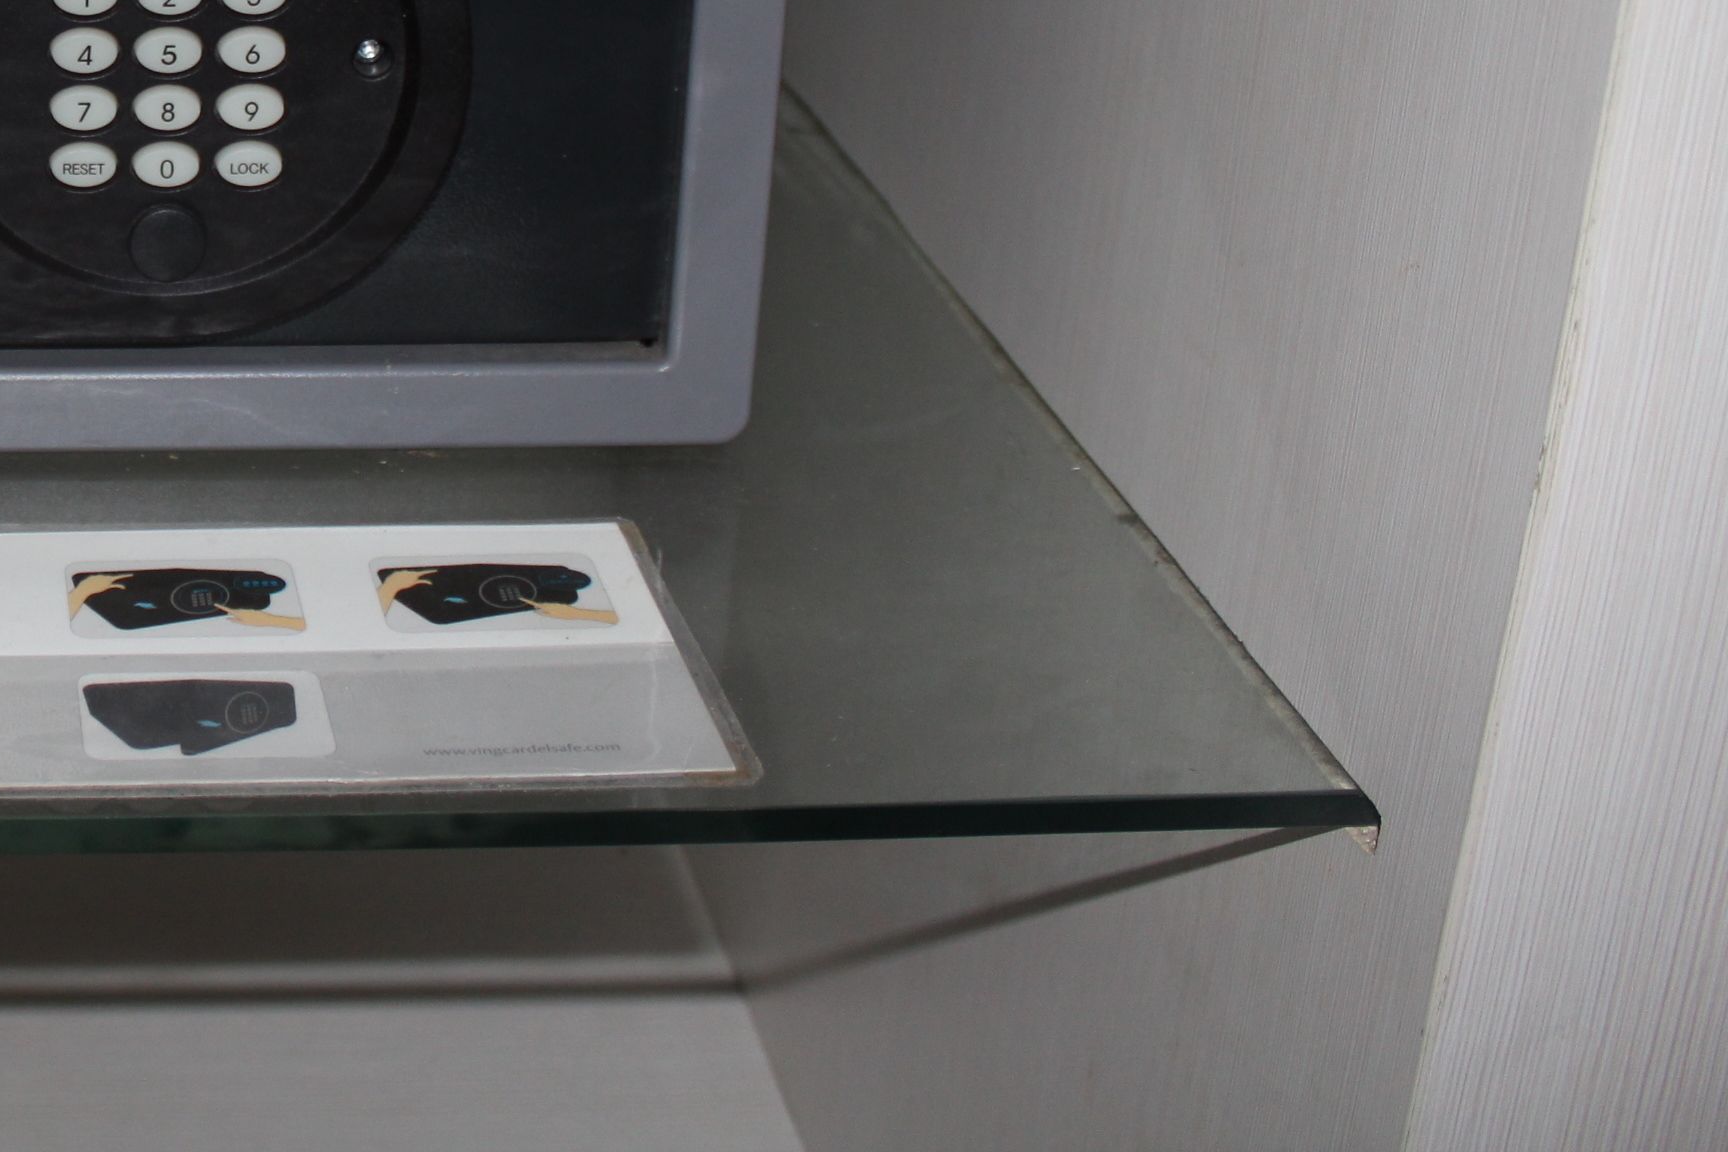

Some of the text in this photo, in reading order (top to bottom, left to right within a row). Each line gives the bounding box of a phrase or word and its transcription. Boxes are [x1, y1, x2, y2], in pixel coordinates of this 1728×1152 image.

[77, 45, 92, 65] 4
[161, 45, 177, 65] 5
[246, 45, 260, 64] 6
[78, 102, 91, 122] 7
[161, 103, 175, 122] 8
[245, 102, 258, 121] 9
[62, 163, 105, 175] RESET
[160, 160, 174, 179] 0
[230, 163, 269, 175] LOCK
